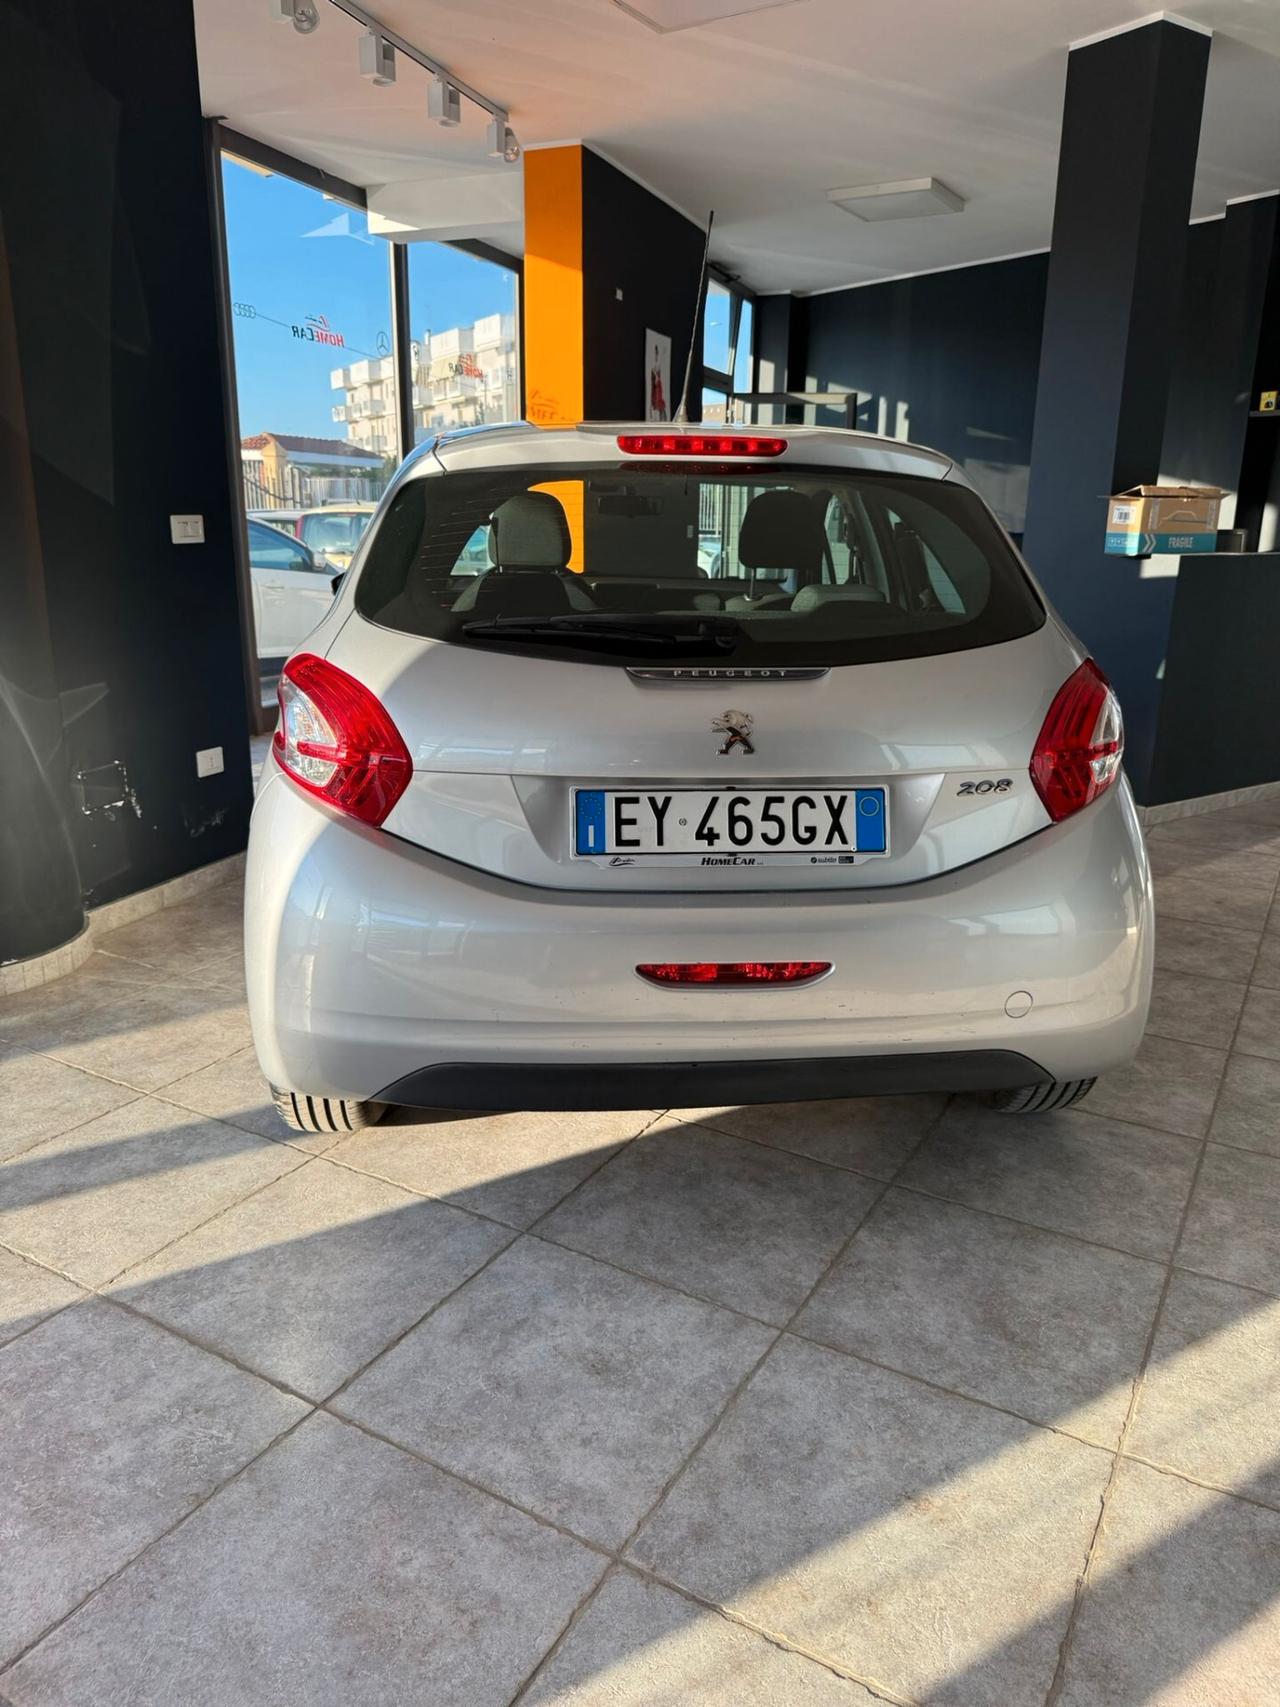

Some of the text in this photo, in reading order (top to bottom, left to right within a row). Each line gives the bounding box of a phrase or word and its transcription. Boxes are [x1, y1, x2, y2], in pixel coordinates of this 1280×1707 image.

[673, 669, 787, 677] PEUGEOT
[956, 778, 1014, 797] 208
[614, 795, 849, 847] EY 465GX
